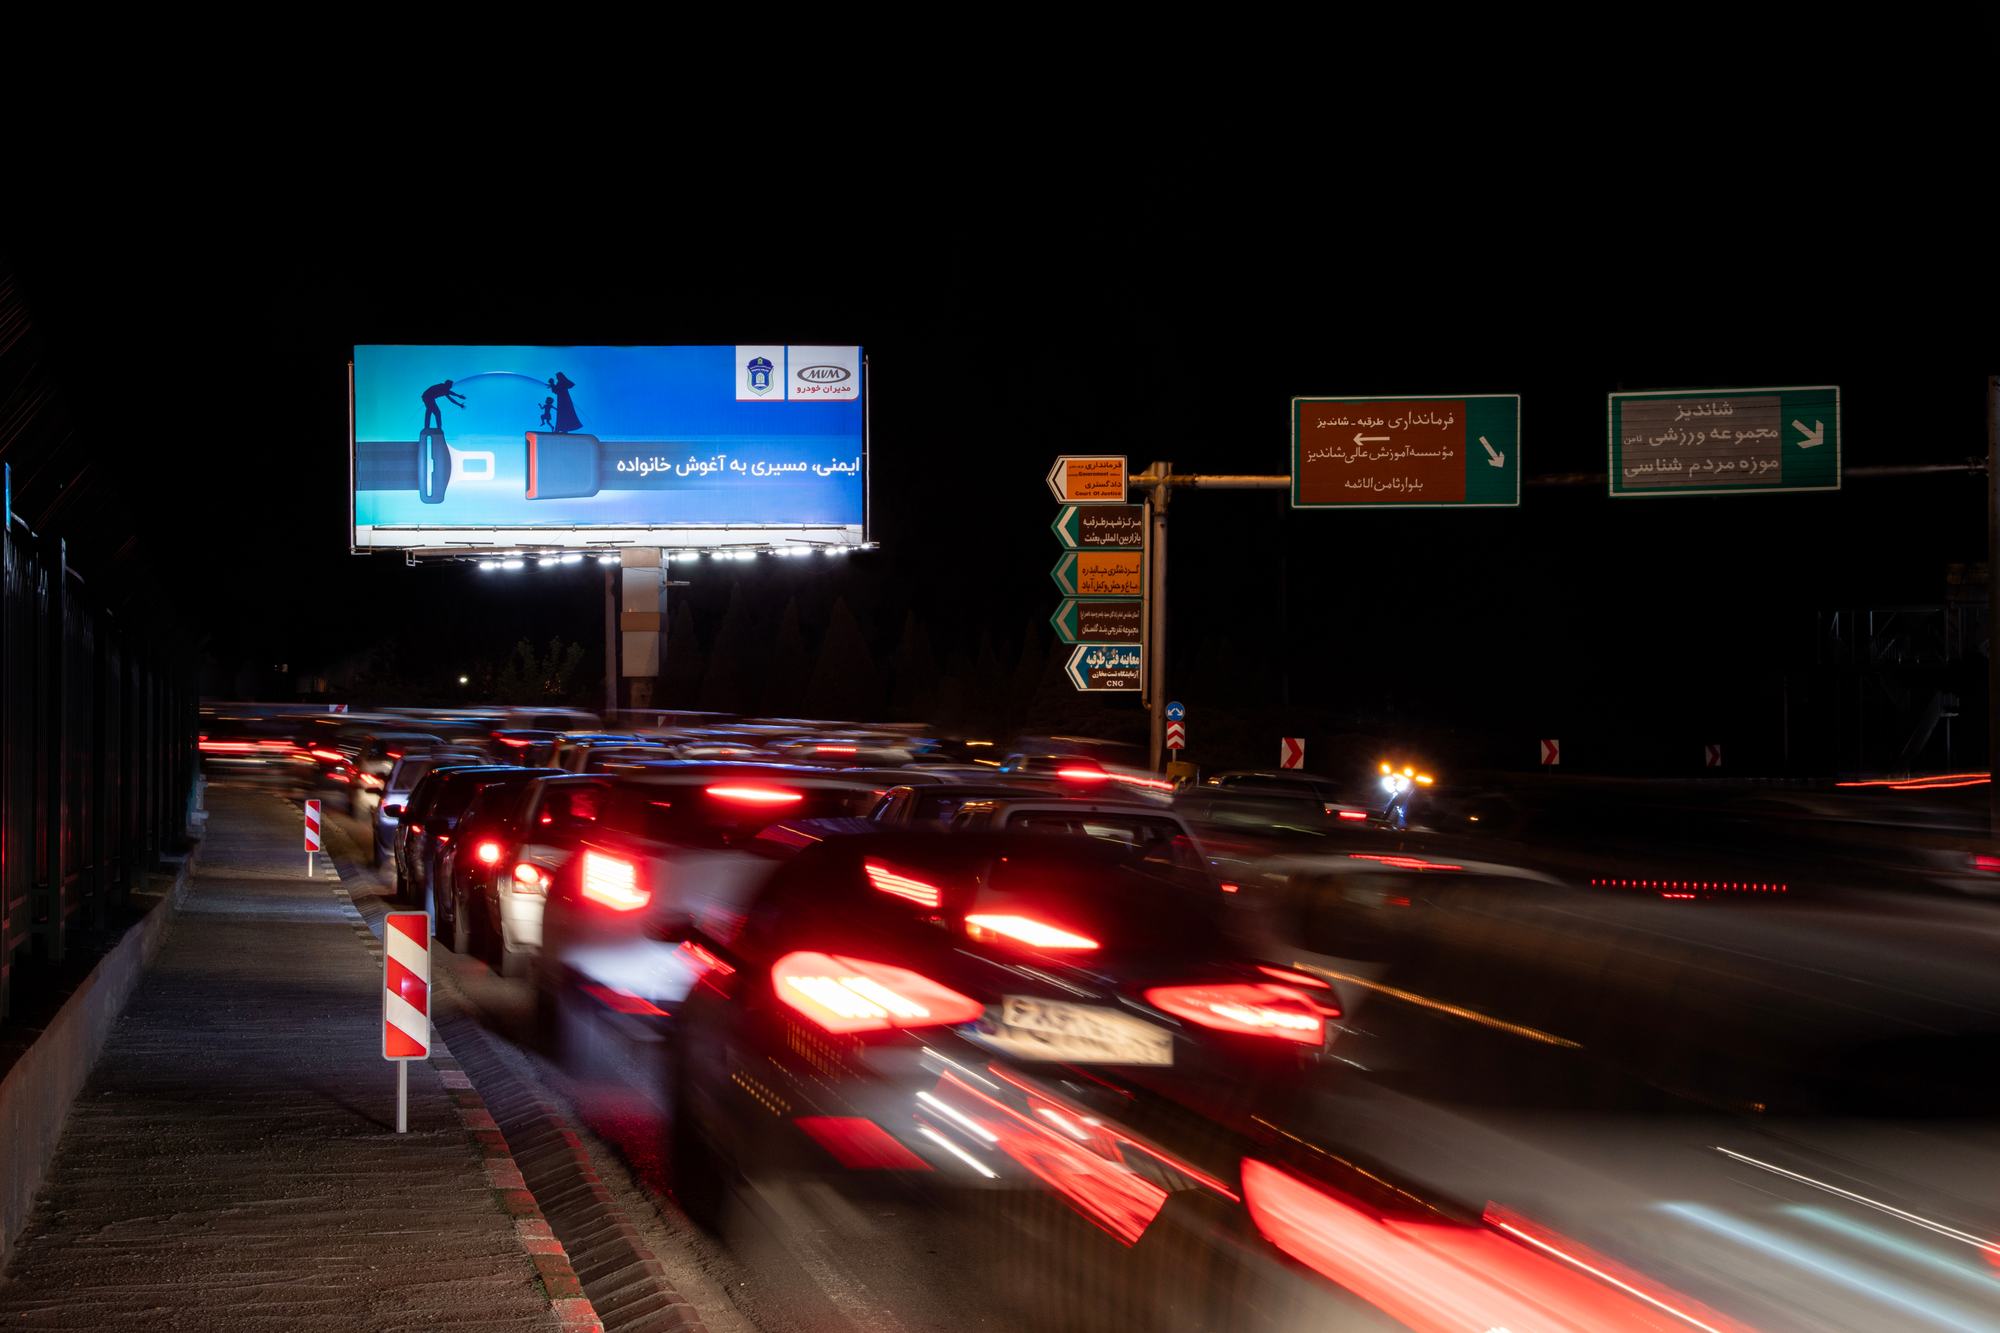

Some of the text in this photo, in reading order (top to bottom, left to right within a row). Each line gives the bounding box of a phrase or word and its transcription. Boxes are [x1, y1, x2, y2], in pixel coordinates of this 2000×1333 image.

[808, 369, 840, 379] MVM
[796, 384, 851, 394] مدیران خودرو
[1675, 401, 1734, 422] شاندیز
[1317, 416, 1349, 429] شاندیز
[1357, 416, 1384, 428] طرقبه
[1388, 411, 1455, 431] فرمانداری
[1649, 427, 1706, 447] ورزشی
[1710, 427, 1779, 445] مجموعه
[1307, 446, 1346, 463] شاندیز
[1344, 446, 1368, 464] عالی
[1369, 445, 1411, 461] آموزش
[617, 455, 861, 477] ایمنی، مسیری به آغوش خانواده
[1624, 458, 1683, 478] شناسی
[1739, 456, 1779, 475] موزه
[1374, 477, 1401, 491] ثامن
[1400, 477, 1424, 492] بلوار
[1082, 516, 1106, 529] طرقبه
[1121, 517, 1142, 529] مرکز
